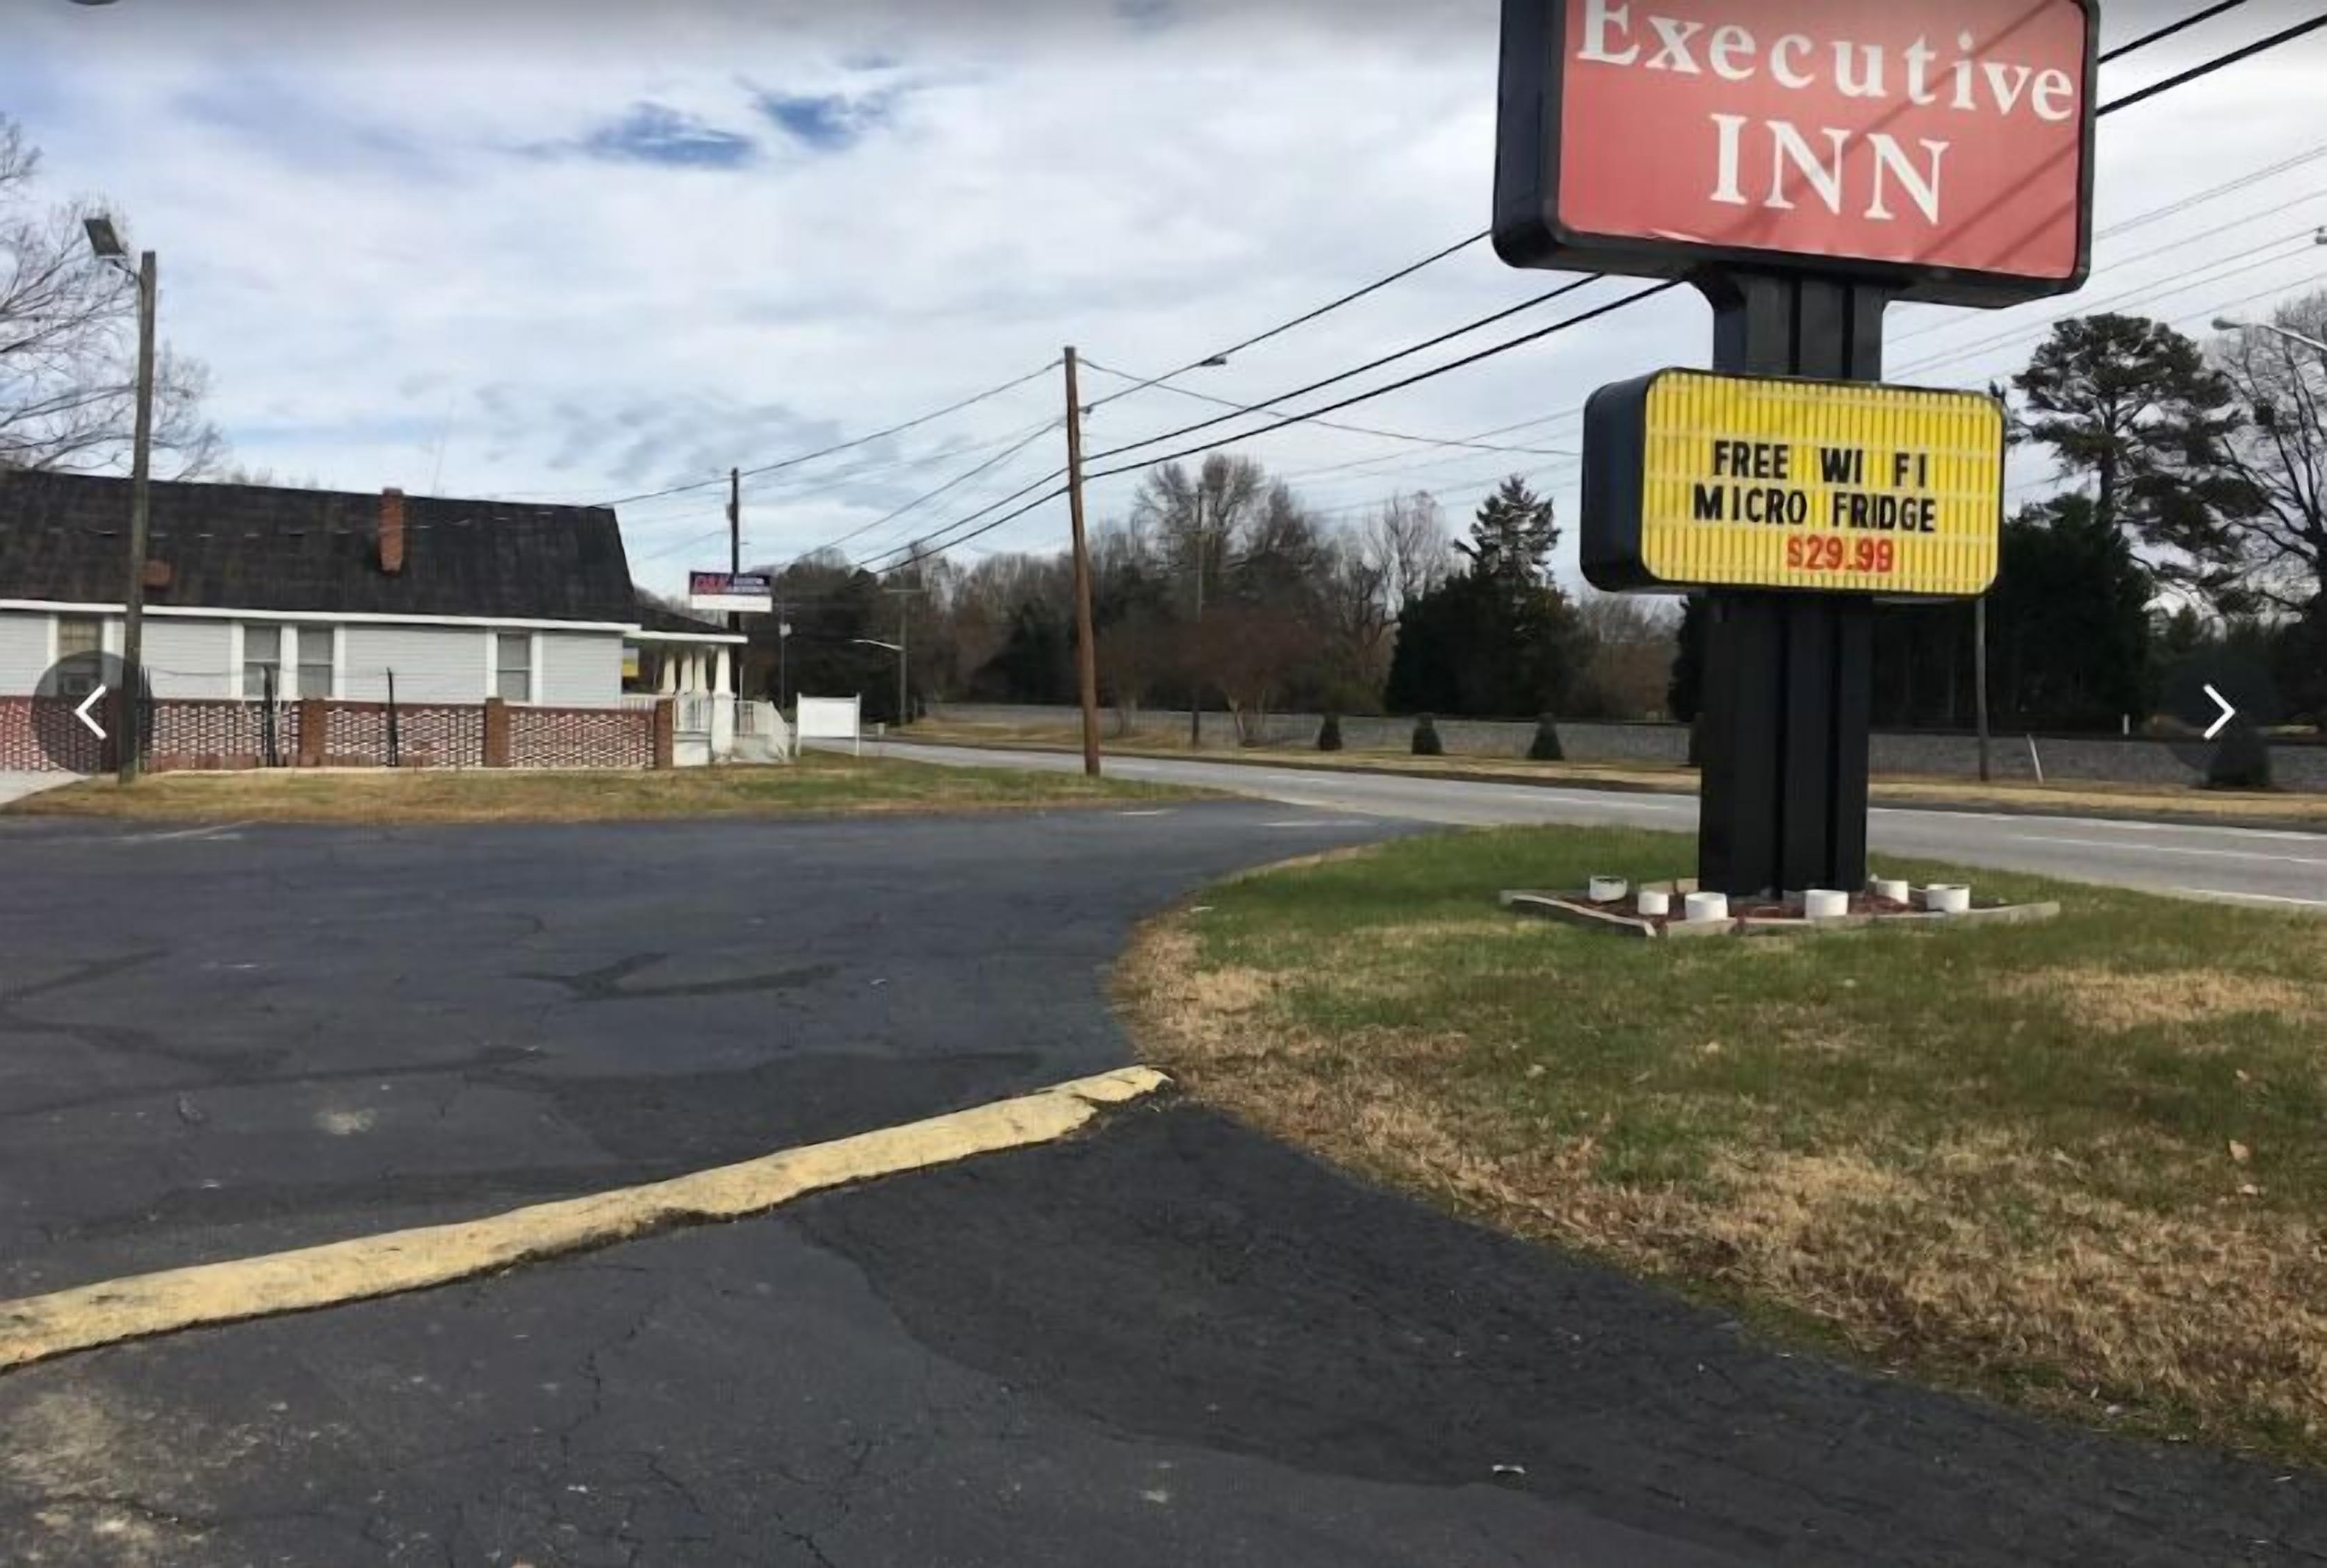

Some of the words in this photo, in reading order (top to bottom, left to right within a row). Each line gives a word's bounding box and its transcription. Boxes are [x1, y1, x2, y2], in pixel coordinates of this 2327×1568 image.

[1576, 0, 2073, 120] Executive
[1710, 113, 1950, 224] INN
[1713, 441, 1789, 480] FREE
[1821, 448, 1863, 484] WI
[1694, 484, 1808, 524] MICRO
[1832, 493, 1936, 532] FRIDGE
